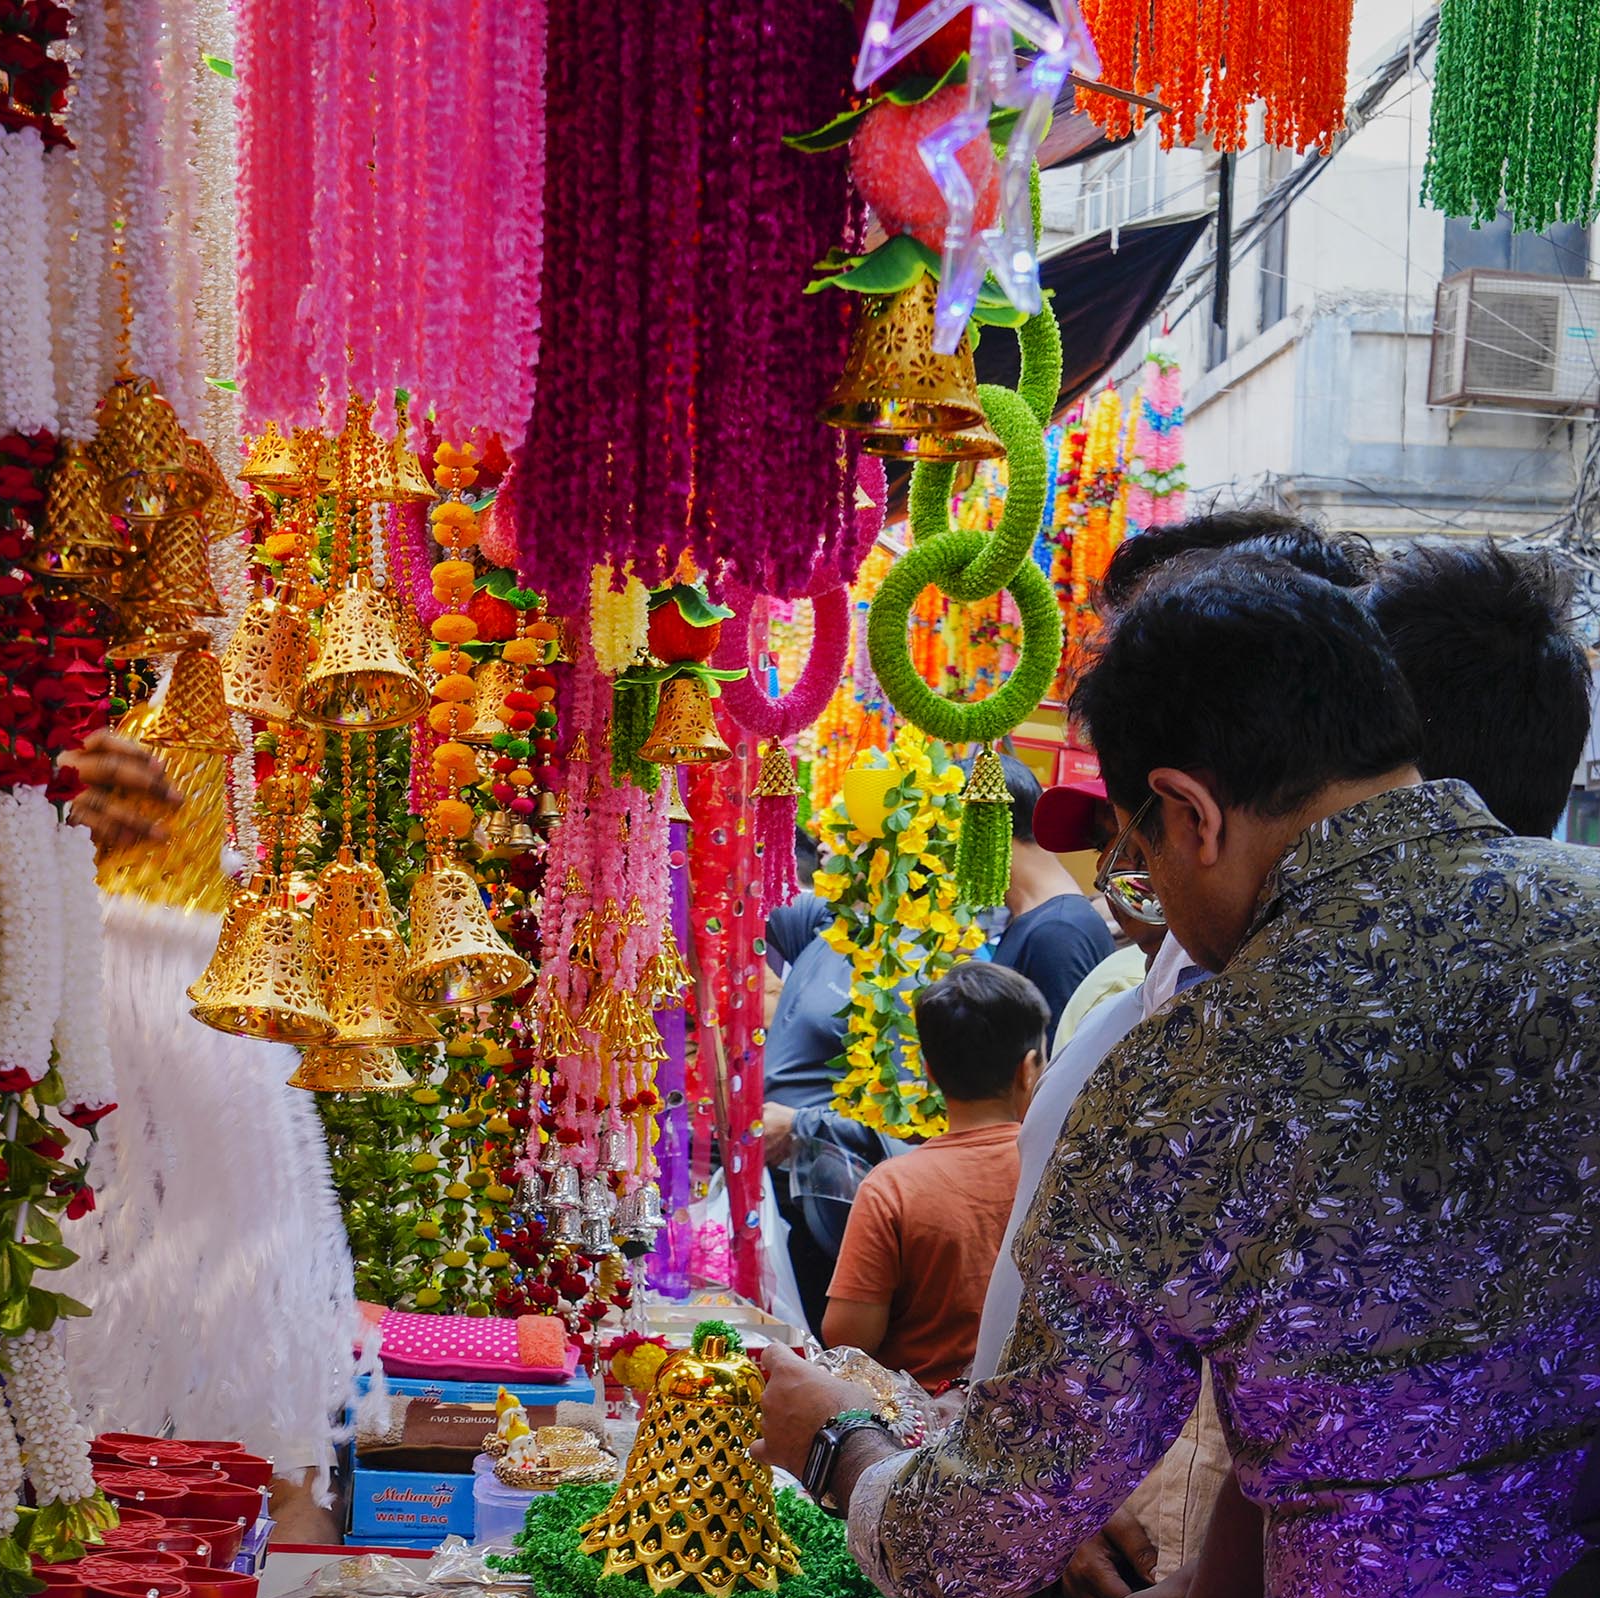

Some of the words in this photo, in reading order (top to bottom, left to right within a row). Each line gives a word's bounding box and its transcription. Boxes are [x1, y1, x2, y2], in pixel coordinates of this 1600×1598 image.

[373, 1487, 451, 1508] Maharaja
[376, 1512, 416, 1522] WARM
[420, 1515, 448, 1524] BAG
